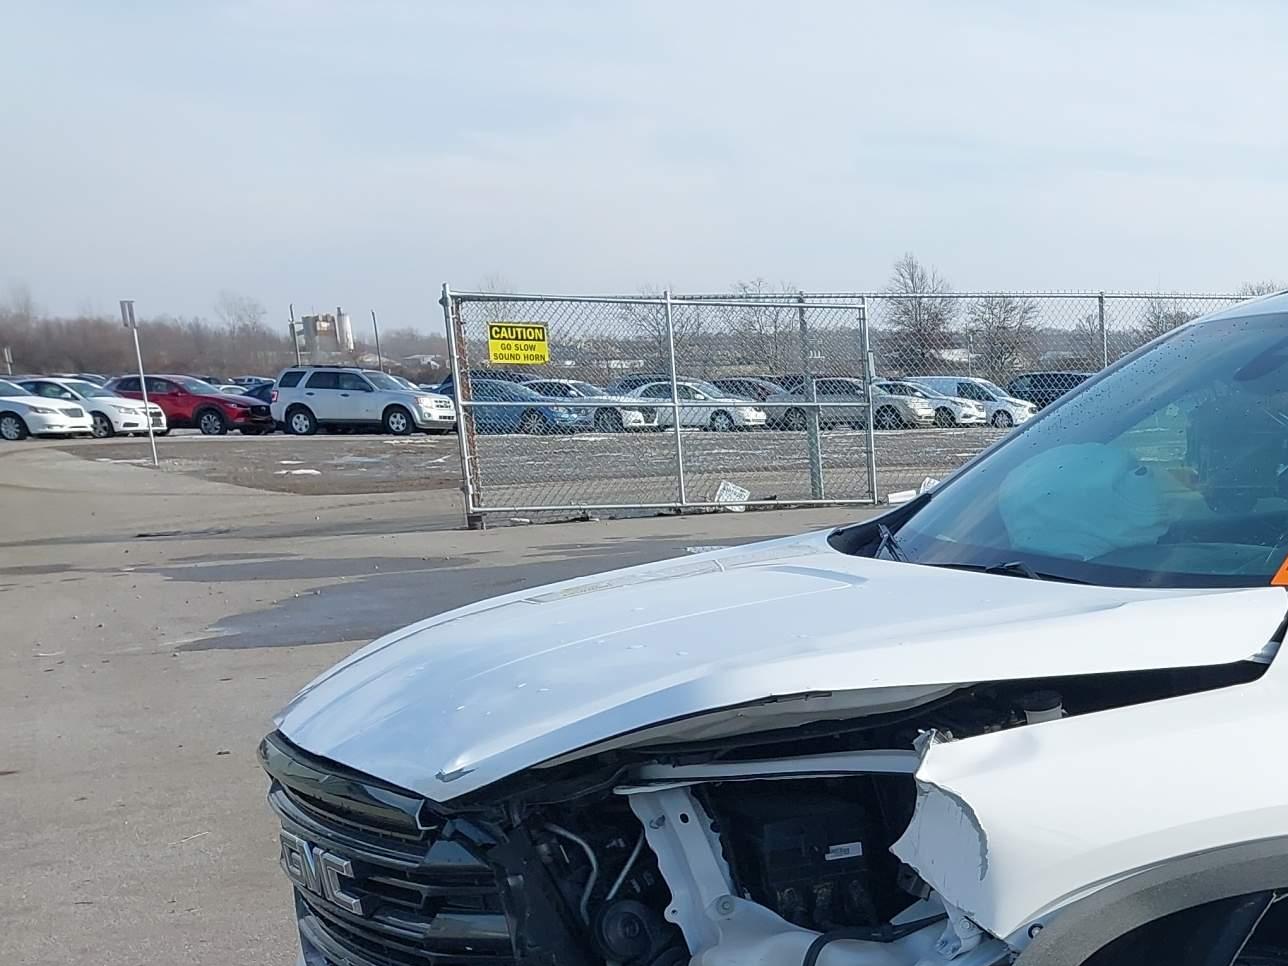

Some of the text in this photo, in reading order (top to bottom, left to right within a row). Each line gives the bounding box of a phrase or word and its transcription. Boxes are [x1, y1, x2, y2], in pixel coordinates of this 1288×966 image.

[491, 326, 544, 340] CAUTION
[500, 343, 536, 351] GO SLOW
[493, 353, 546, 362] SOUND HORN
[279, 829, 363, 916] GMC
